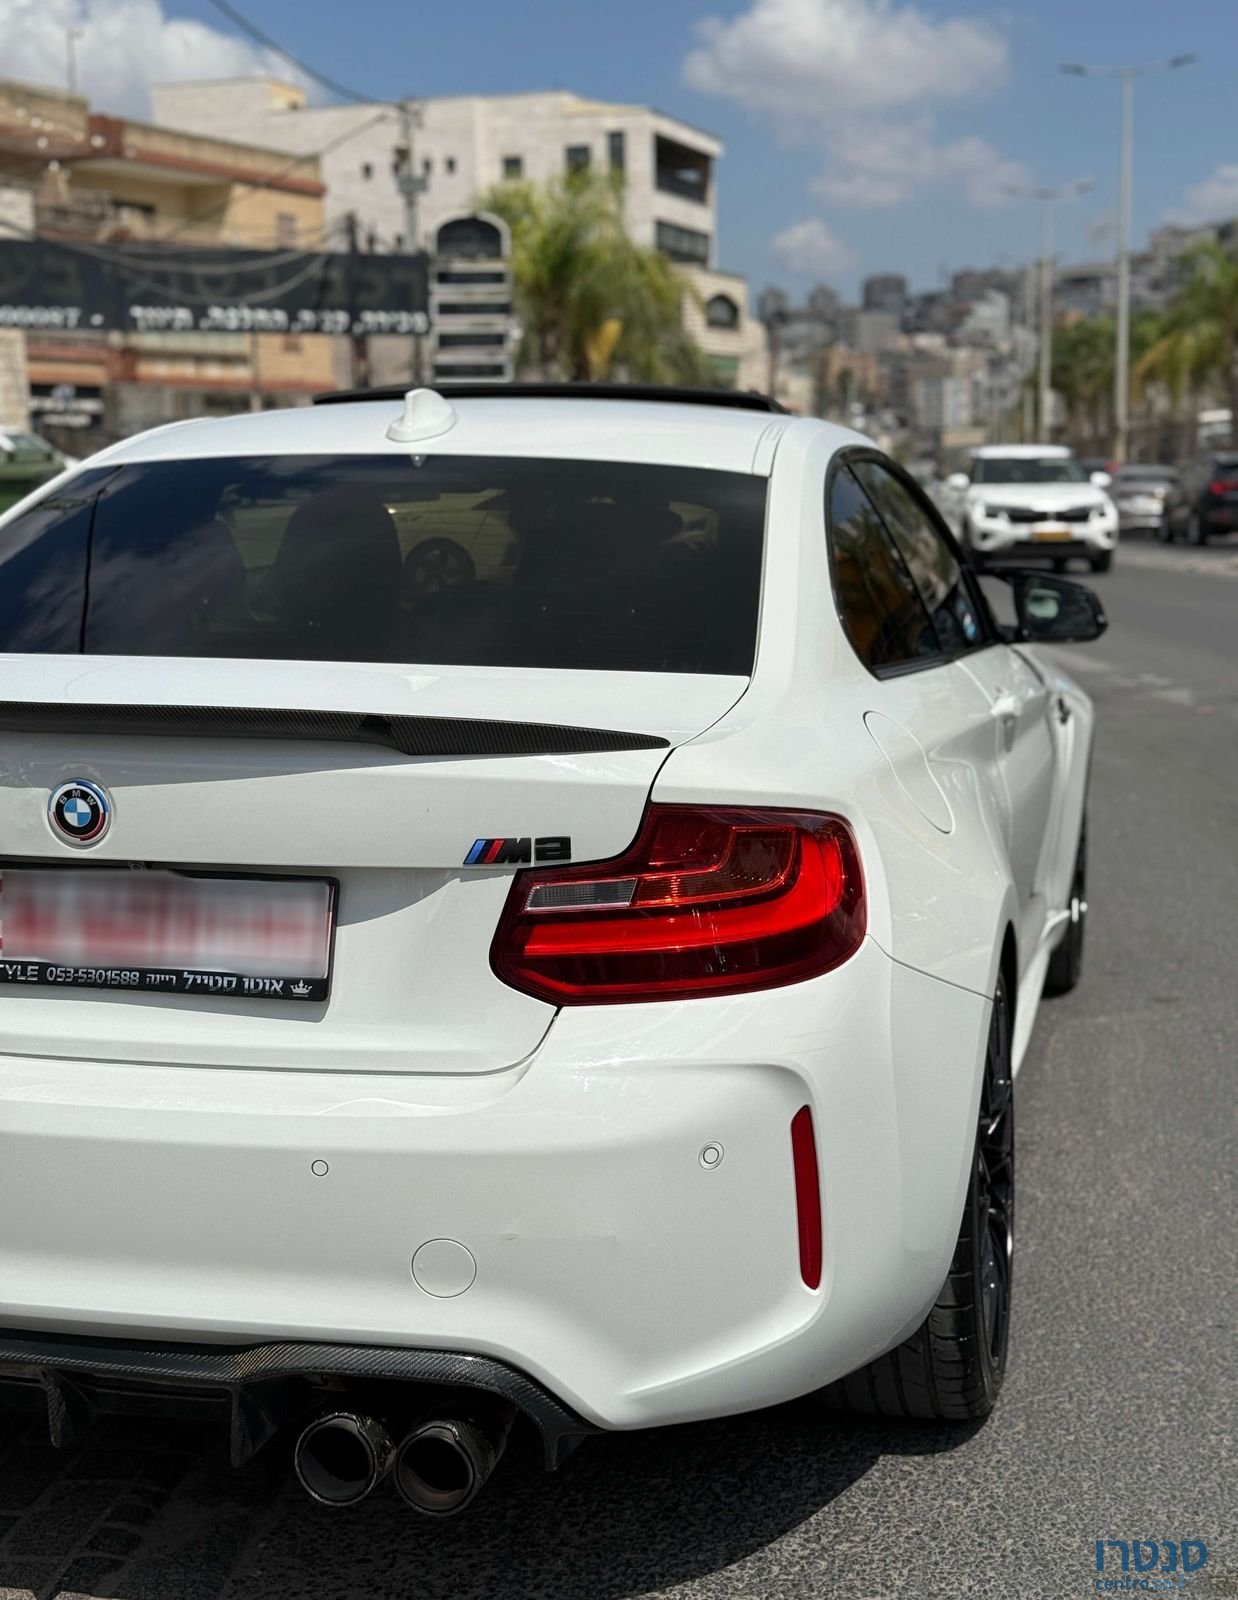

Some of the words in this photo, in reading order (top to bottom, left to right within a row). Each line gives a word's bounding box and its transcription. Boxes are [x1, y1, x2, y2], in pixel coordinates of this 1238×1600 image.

[58, 789, 97, 806] BMW
[490, 836, 571, 864] M2
[46, 966, 140, 985] 053-5301588
[183, 971, 238, 993] סטייל
[242, 976, 284, 995] אוטו
